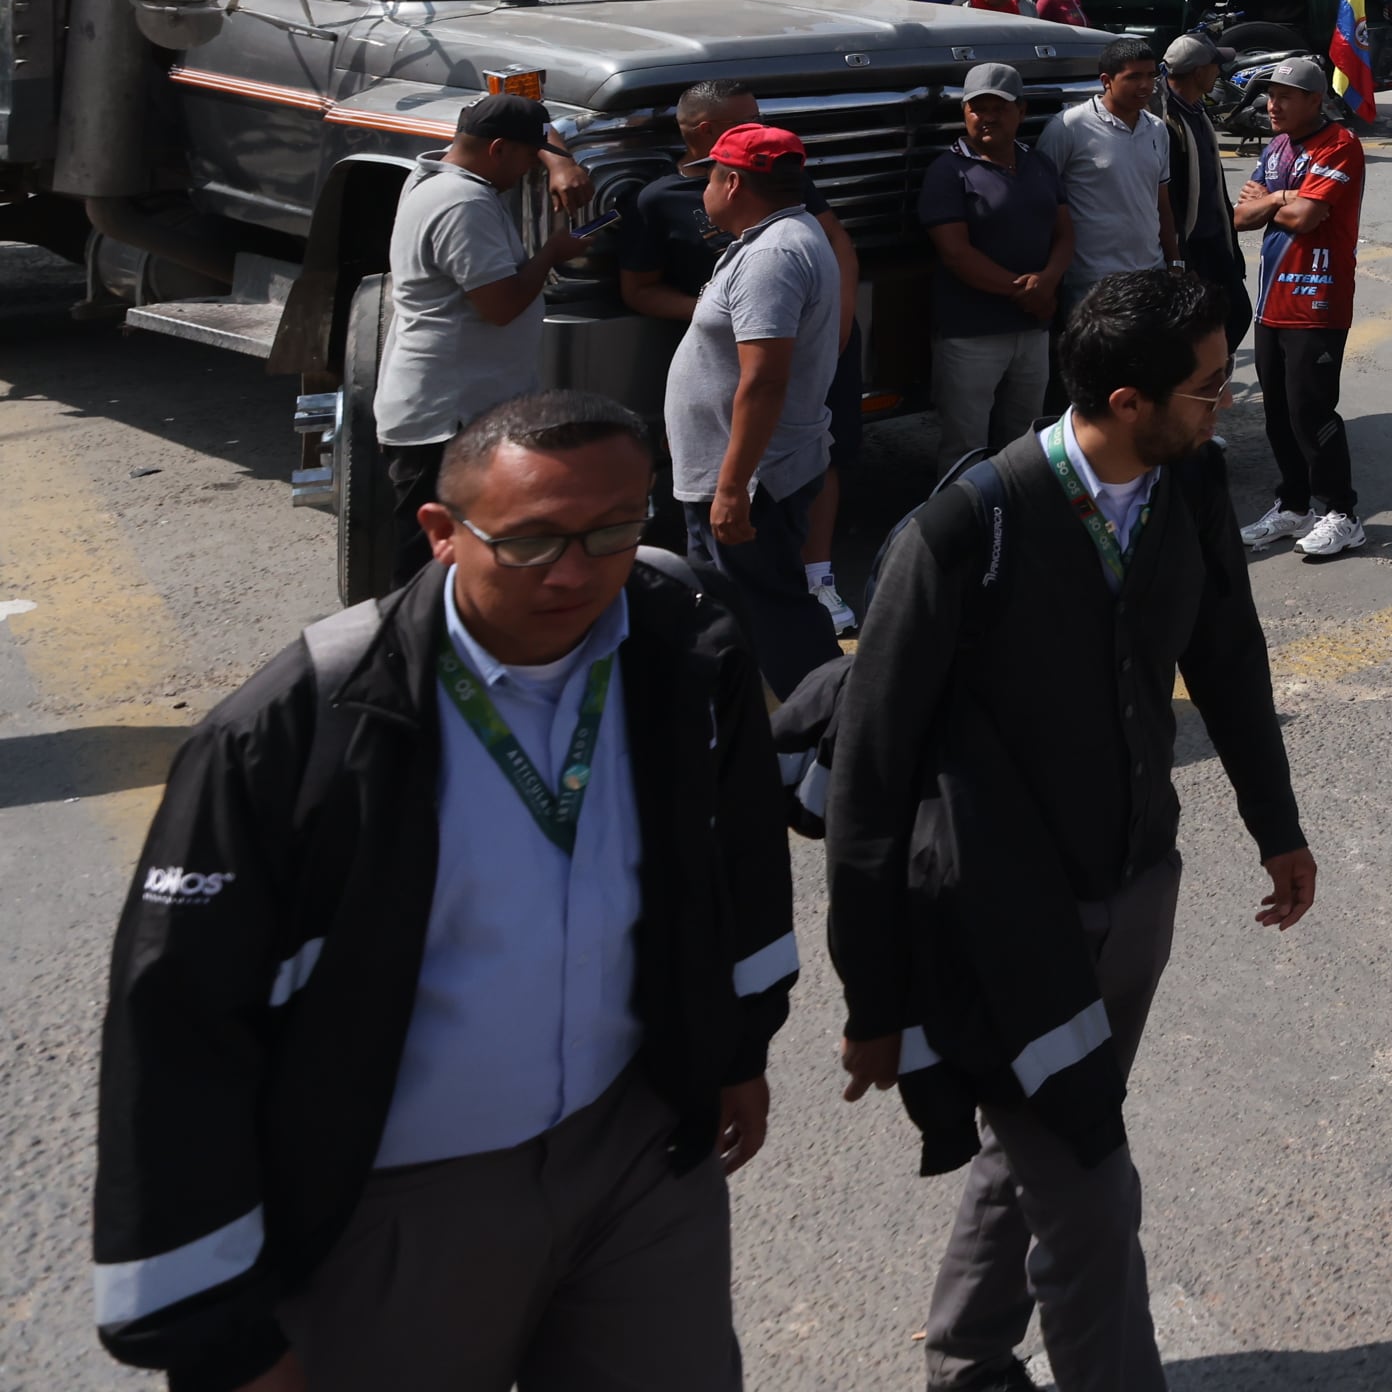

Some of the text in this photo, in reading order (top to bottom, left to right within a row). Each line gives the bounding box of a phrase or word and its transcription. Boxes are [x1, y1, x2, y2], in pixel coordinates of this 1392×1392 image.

[1310, 247, 1330, 272] 11
[1277, 272, 1334, 285] ARTENAL
[1291, 285, 1318, 296] JYE
